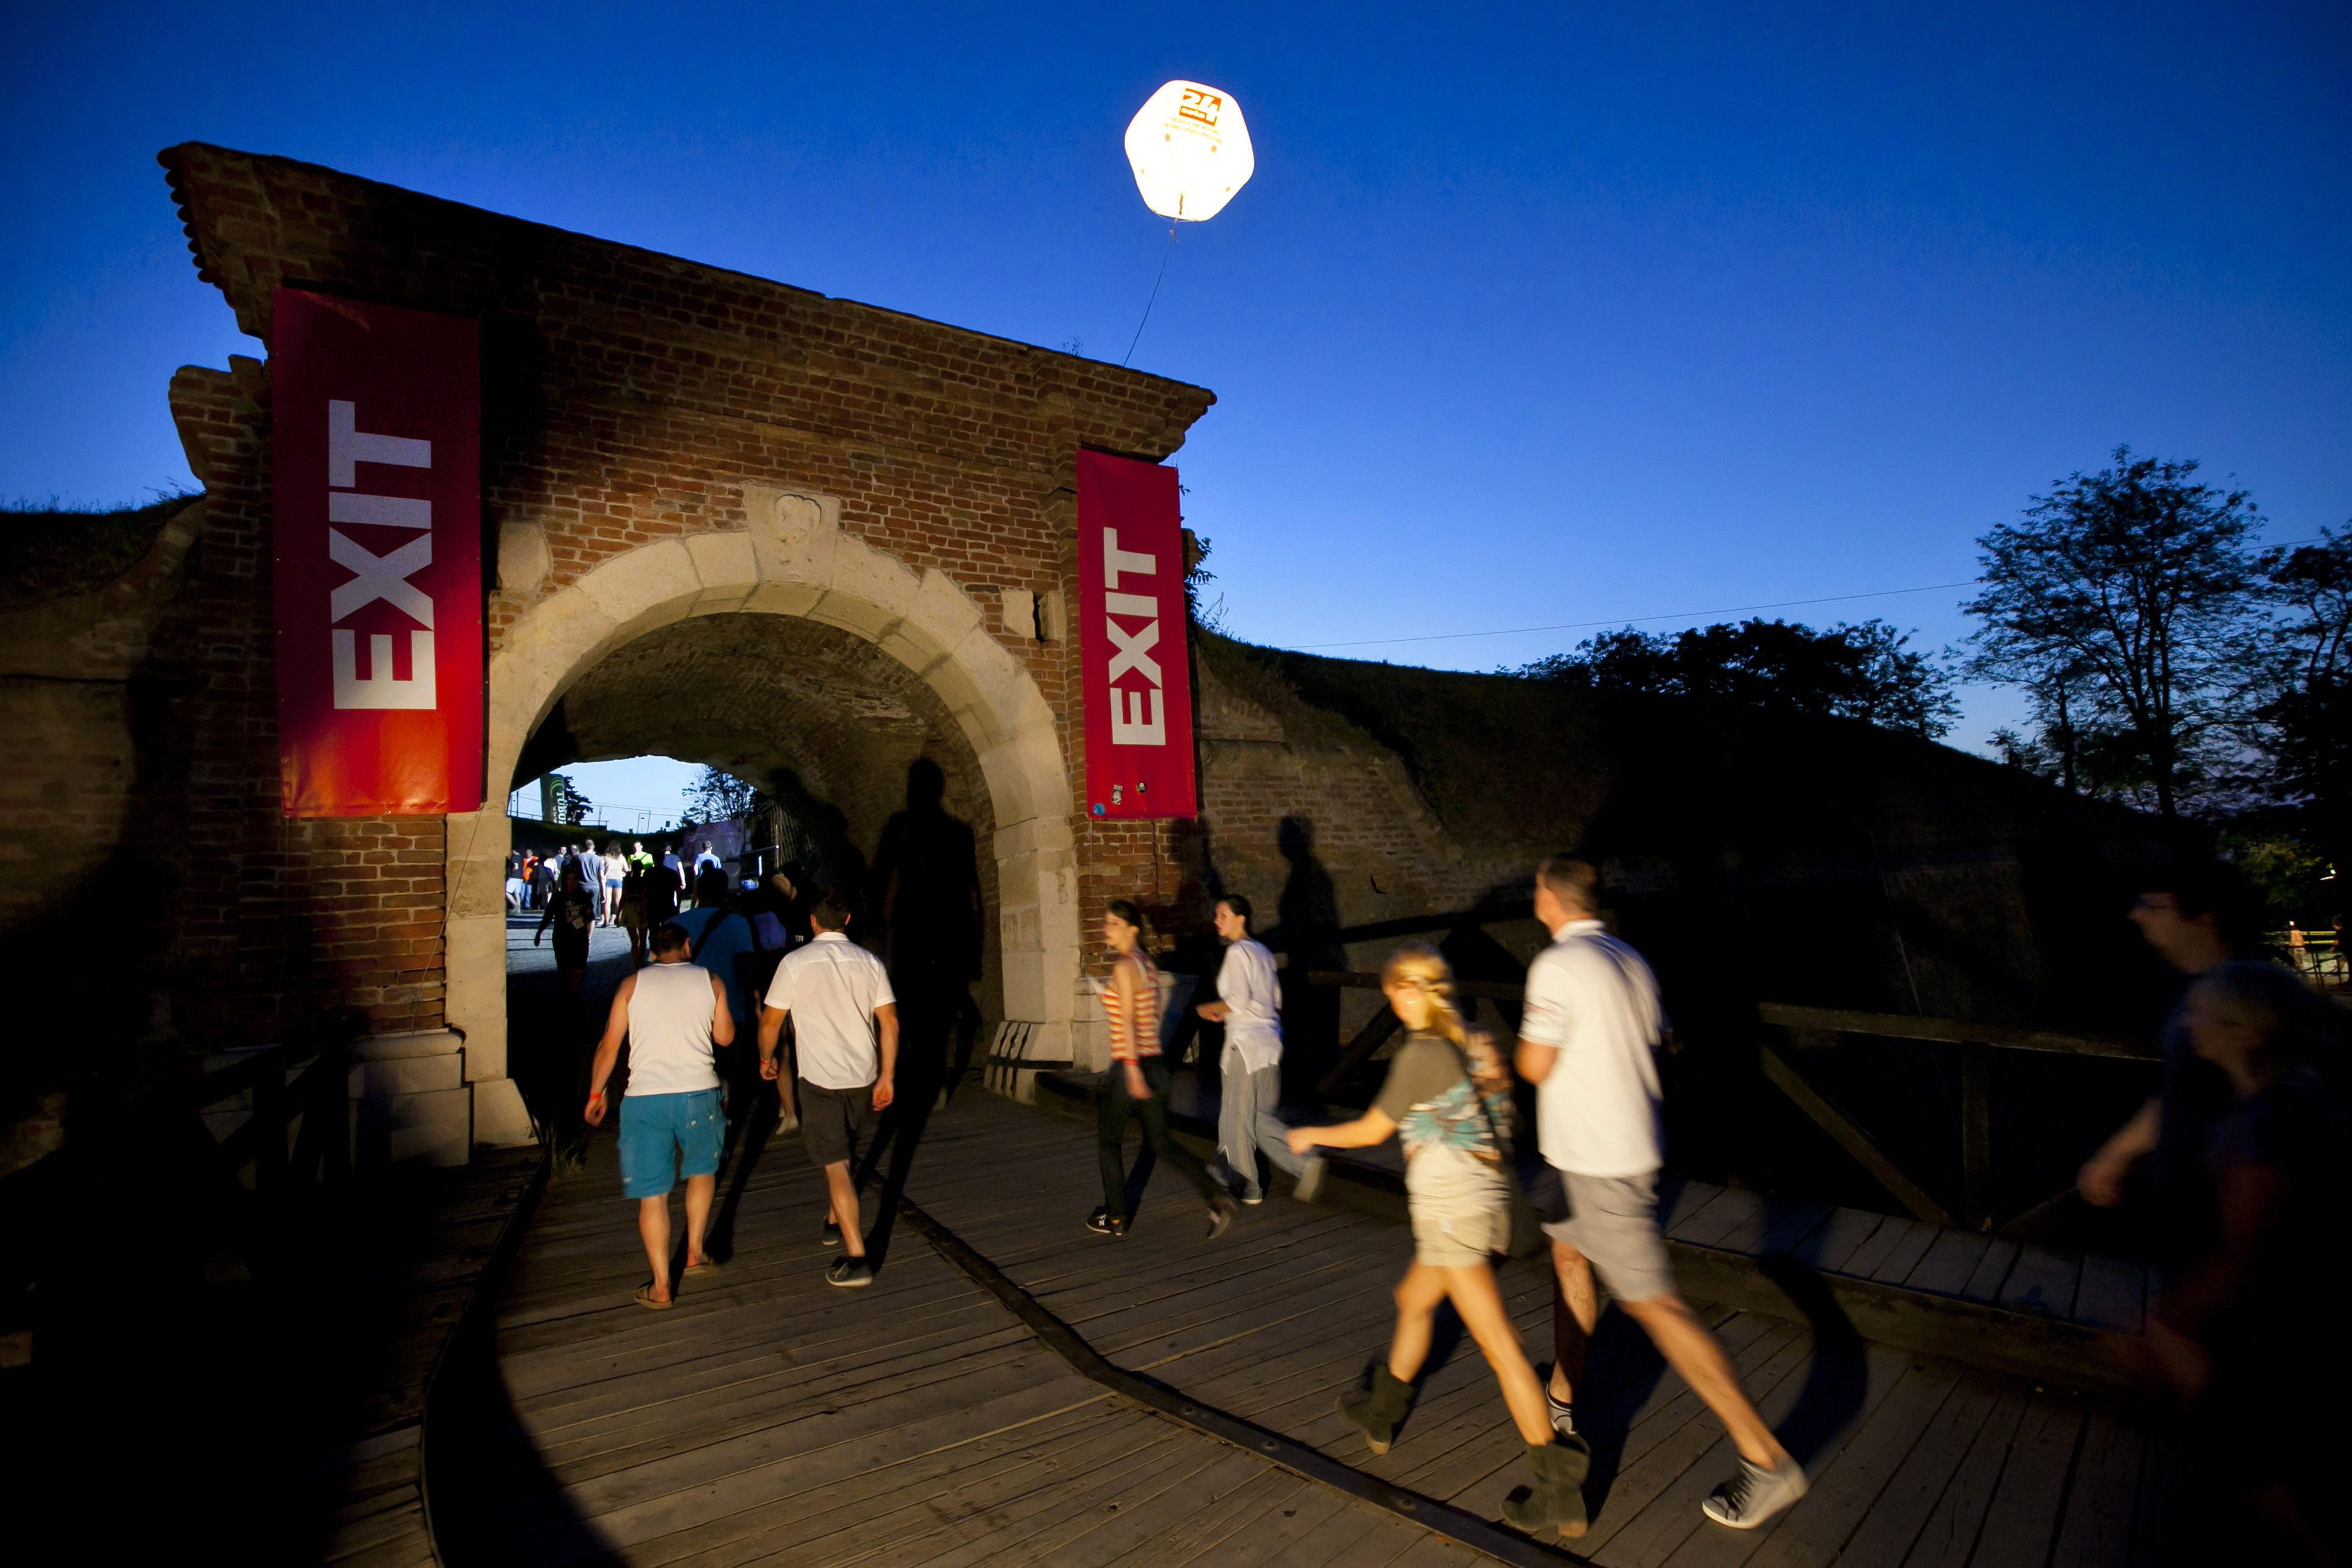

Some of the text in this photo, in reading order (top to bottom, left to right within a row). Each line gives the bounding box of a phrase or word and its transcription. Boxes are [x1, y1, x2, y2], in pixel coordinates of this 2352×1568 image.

[1182, 91, 1219, 122] 24
[329, 400, 437, 710] EXIT
[1103, 527, 1167, 746] EXIT
